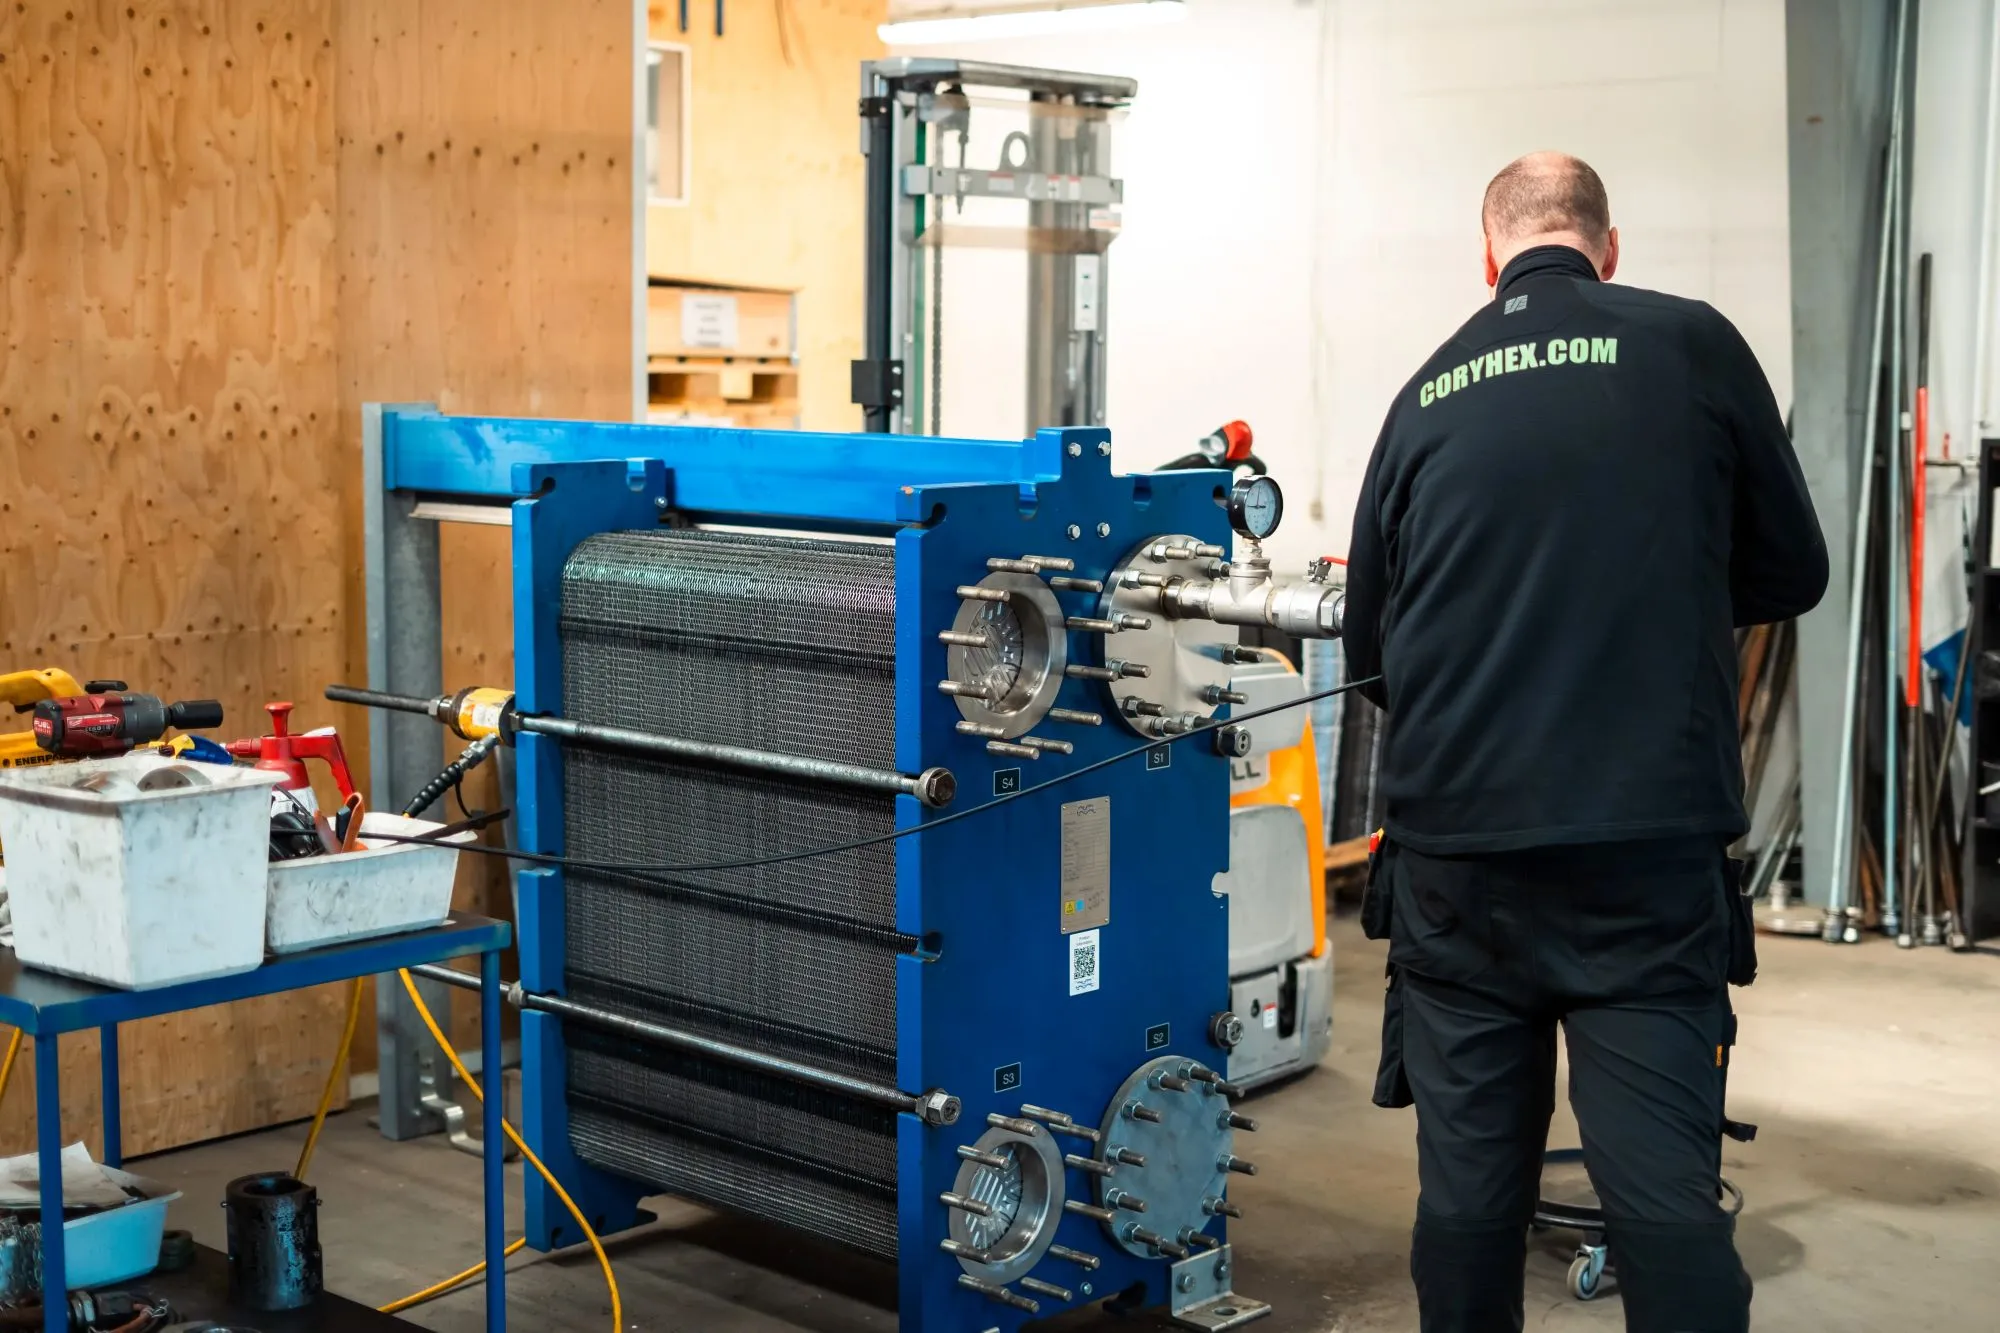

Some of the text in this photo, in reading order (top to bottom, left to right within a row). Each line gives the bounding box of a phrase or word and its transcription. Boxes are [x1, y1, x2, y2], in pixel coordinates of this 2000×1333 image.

[1420, 338, 1618, 408] CORYHEX.COM
[1153, 753, 1164, 764] S1
[1002, 777, 1014, 789] S4
[1153, 1032, 1164, 1044] S2
[1002, 1072, 1015, 1085] S3
